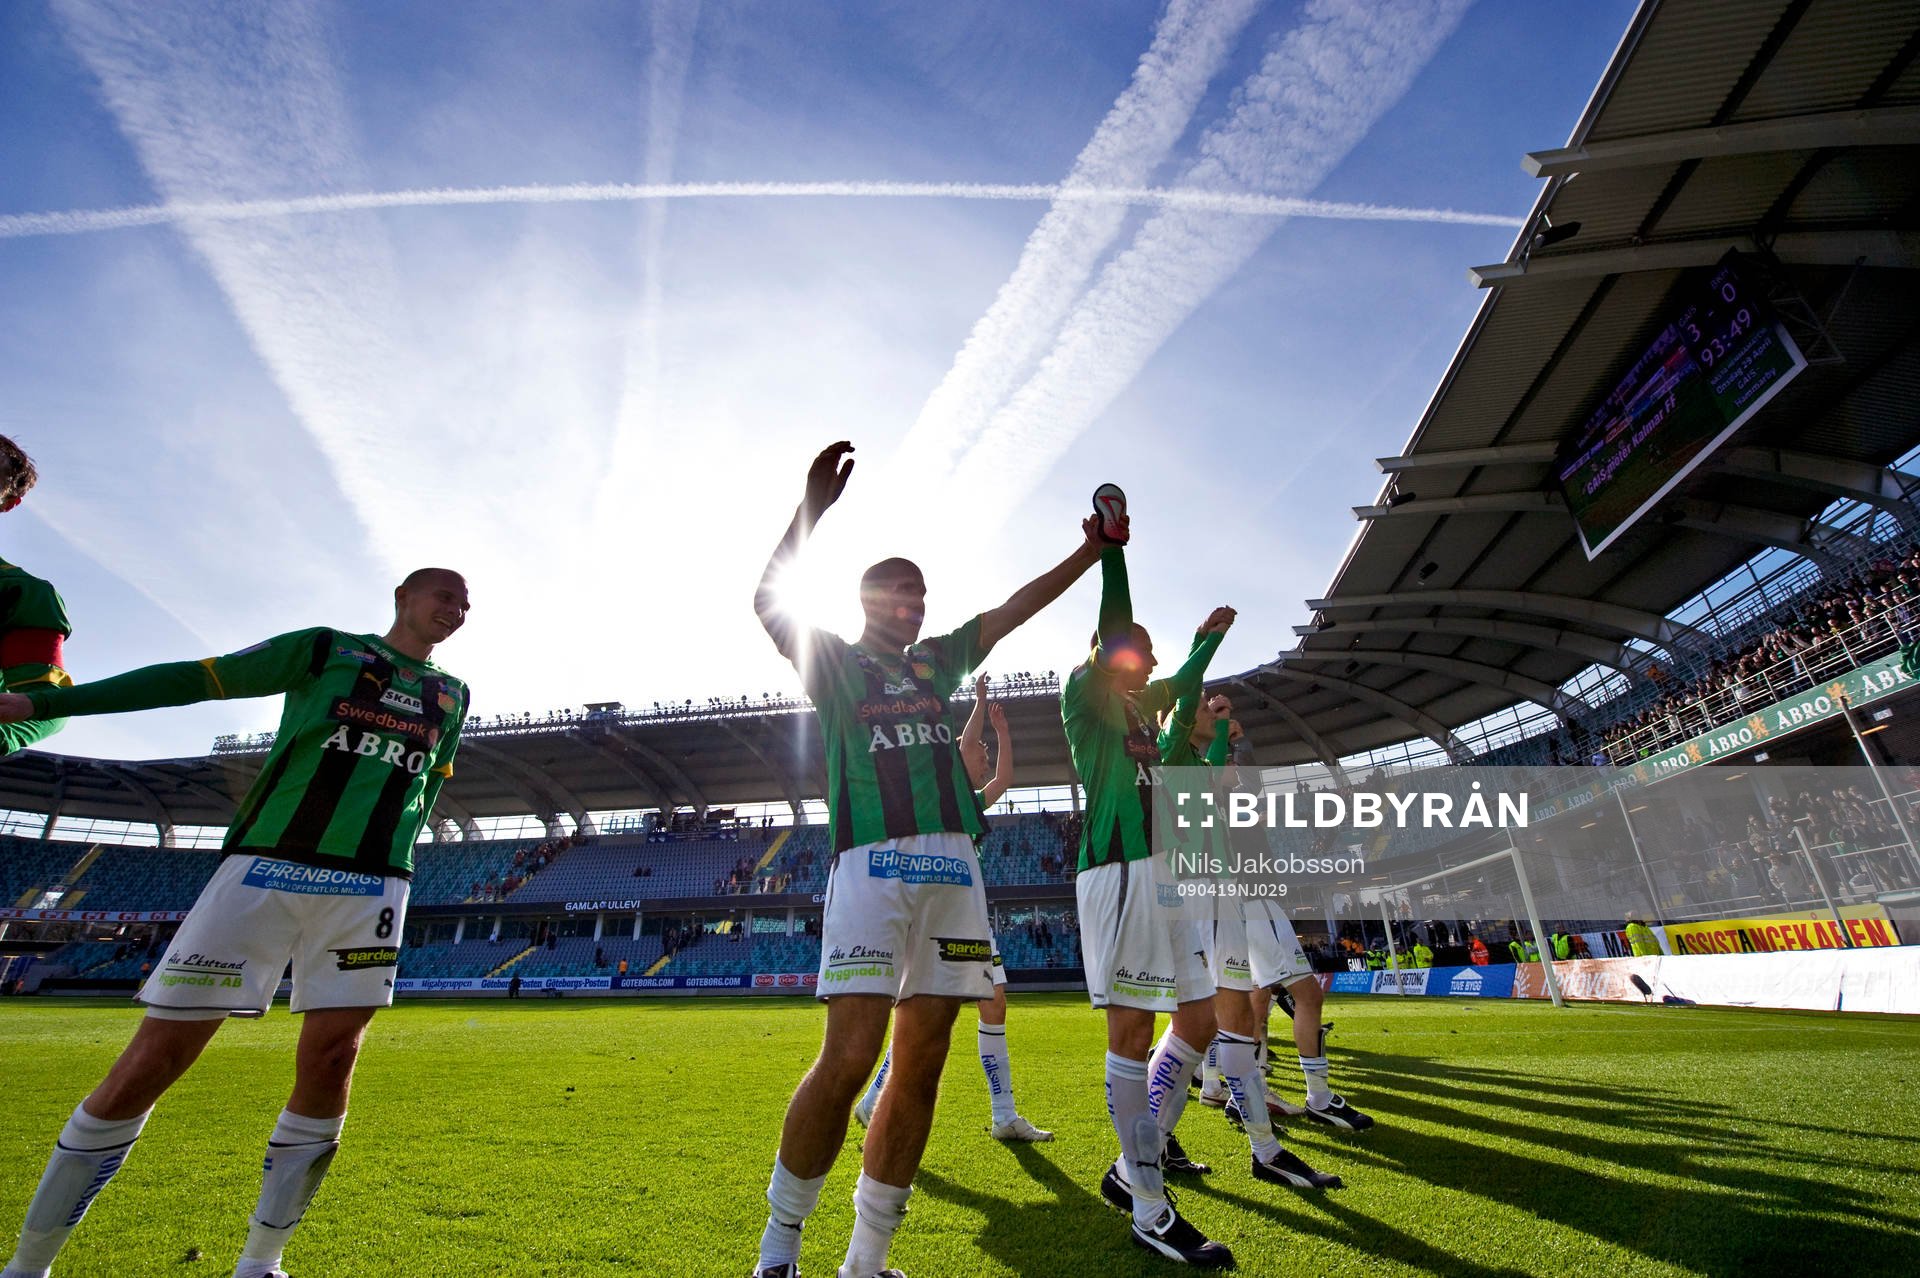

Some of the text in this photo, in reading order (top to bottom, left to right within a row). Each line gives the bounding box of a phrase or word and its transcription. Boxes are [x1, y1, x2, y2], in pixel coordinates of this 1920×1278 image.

[1687, 323, 1701, 343] 3
[1721, 282, 1736, 303] 0
[1701, 308, 1751, 368] 93:49
[1631, 409, 1664, 447] Kalmar
[1664, 394, 1676, 413] FF
[1862, 663, 1913, 697] ÅBR
[385, 690, 421, 708] SKAB
[335, 701, 427, 738] Swedbank
[1777, 696, 1831, 731] ÅBRO
[320, 725, 425, 774] ÅBRO
[868, 724, 951, 753] ÅBRO
[1709, 727, 1753, 757] ÅBRO
[1653, 753, 1690, 779] ÅBRO
[1567, 791, 1594, 811] ÅBRO
[251, 861, 383, 886] EHRENBORGS
[81, 911, 110, 921] GT
[118, 912, 143, 921] GT
[151, 912, 171, 920] GT
[565, 900, 641, 911] GAMLA ULLEVI
[375, 906, 395, 940] 8
[183, 953, 247, 969] Ekstrand
[829, 946, 846, 962] Åke
[219, 977, 243, 988] AB
[546, 977, 609, 990] Göteborgs-Posten
[824, 963, 882, 982] Byggnads
[1116, 966, 1177, 984] Åke Ekstrand
[1465, 980, 1483, 991] BYGG
[981, 1054, 1003, 1096] Folksam
